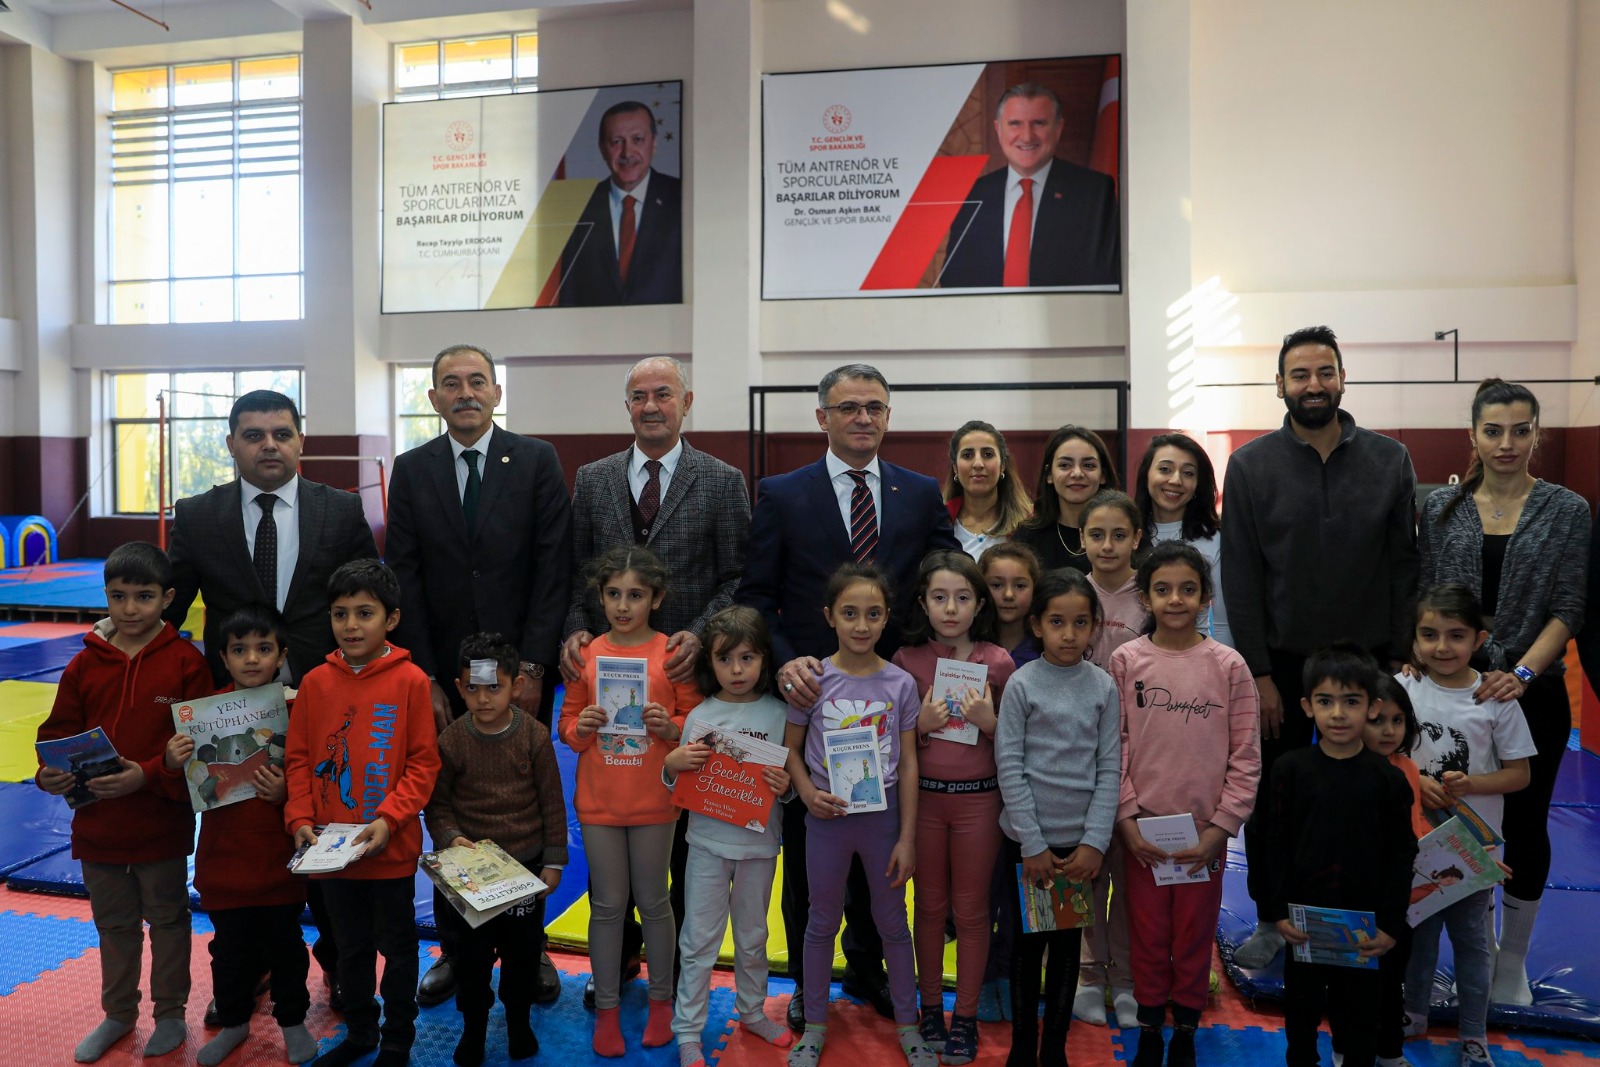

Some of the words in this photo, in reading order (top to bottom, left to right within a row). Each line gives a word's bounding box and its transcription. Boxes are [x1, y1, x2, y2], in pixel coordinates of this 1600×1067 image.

[828, 142, 866, 151] BAKANLIĞI
[777, 160, 806, 174] TÜM
[809, 156, 880, 173] ANTRENÖR
[883, 157, 899, 170] VE
[399, 184, 428, 198] TÜM
[431, 179, 502, 197] ANTRENÖR
[504, 178, 521, 192] VE
[782, 172, 894, 189] SPORCULARIMIZA
[403, 193, 517, 213] SPORCULARIMIZA
[776, 191, 836, 205] BAŞARILAR
[838, 188, 901, 201] DİLİYORUM
[396, 213, 458, 228] BAŞARILAR
[460, 210, 524, 223] DİLİYORUM
[794, 208, 807, 216] Dr.
[808, 207, 837, 216] Osman
[838, 206, 862, 216] Aşkın
[863, 205, 881, 214] BAK
[784, 217, 820, 228] GENÇLİK
[822, 216, 833, 226] VE
[834, 215, 857, 226] SPOR
[859, 214, 892, 224] BAKANI
[416, 240, 438, 248] Recep
[439, 239, 464, 248] Tayyip
[464, 236, 503, 245] ERDOĞAN
[432, 247, 501, 258] CUMHURBAŞKANI
[216, 696, 247, 715] YENİ
[188, 704, 280, 736] KÜTÜPHANECİ
[603, 754, 643, 767] Beauty
[710, 760, 757, 788] Geceler,
[695, 775, 763, 807] Farecikler
[947, 781, 980, 793] good
